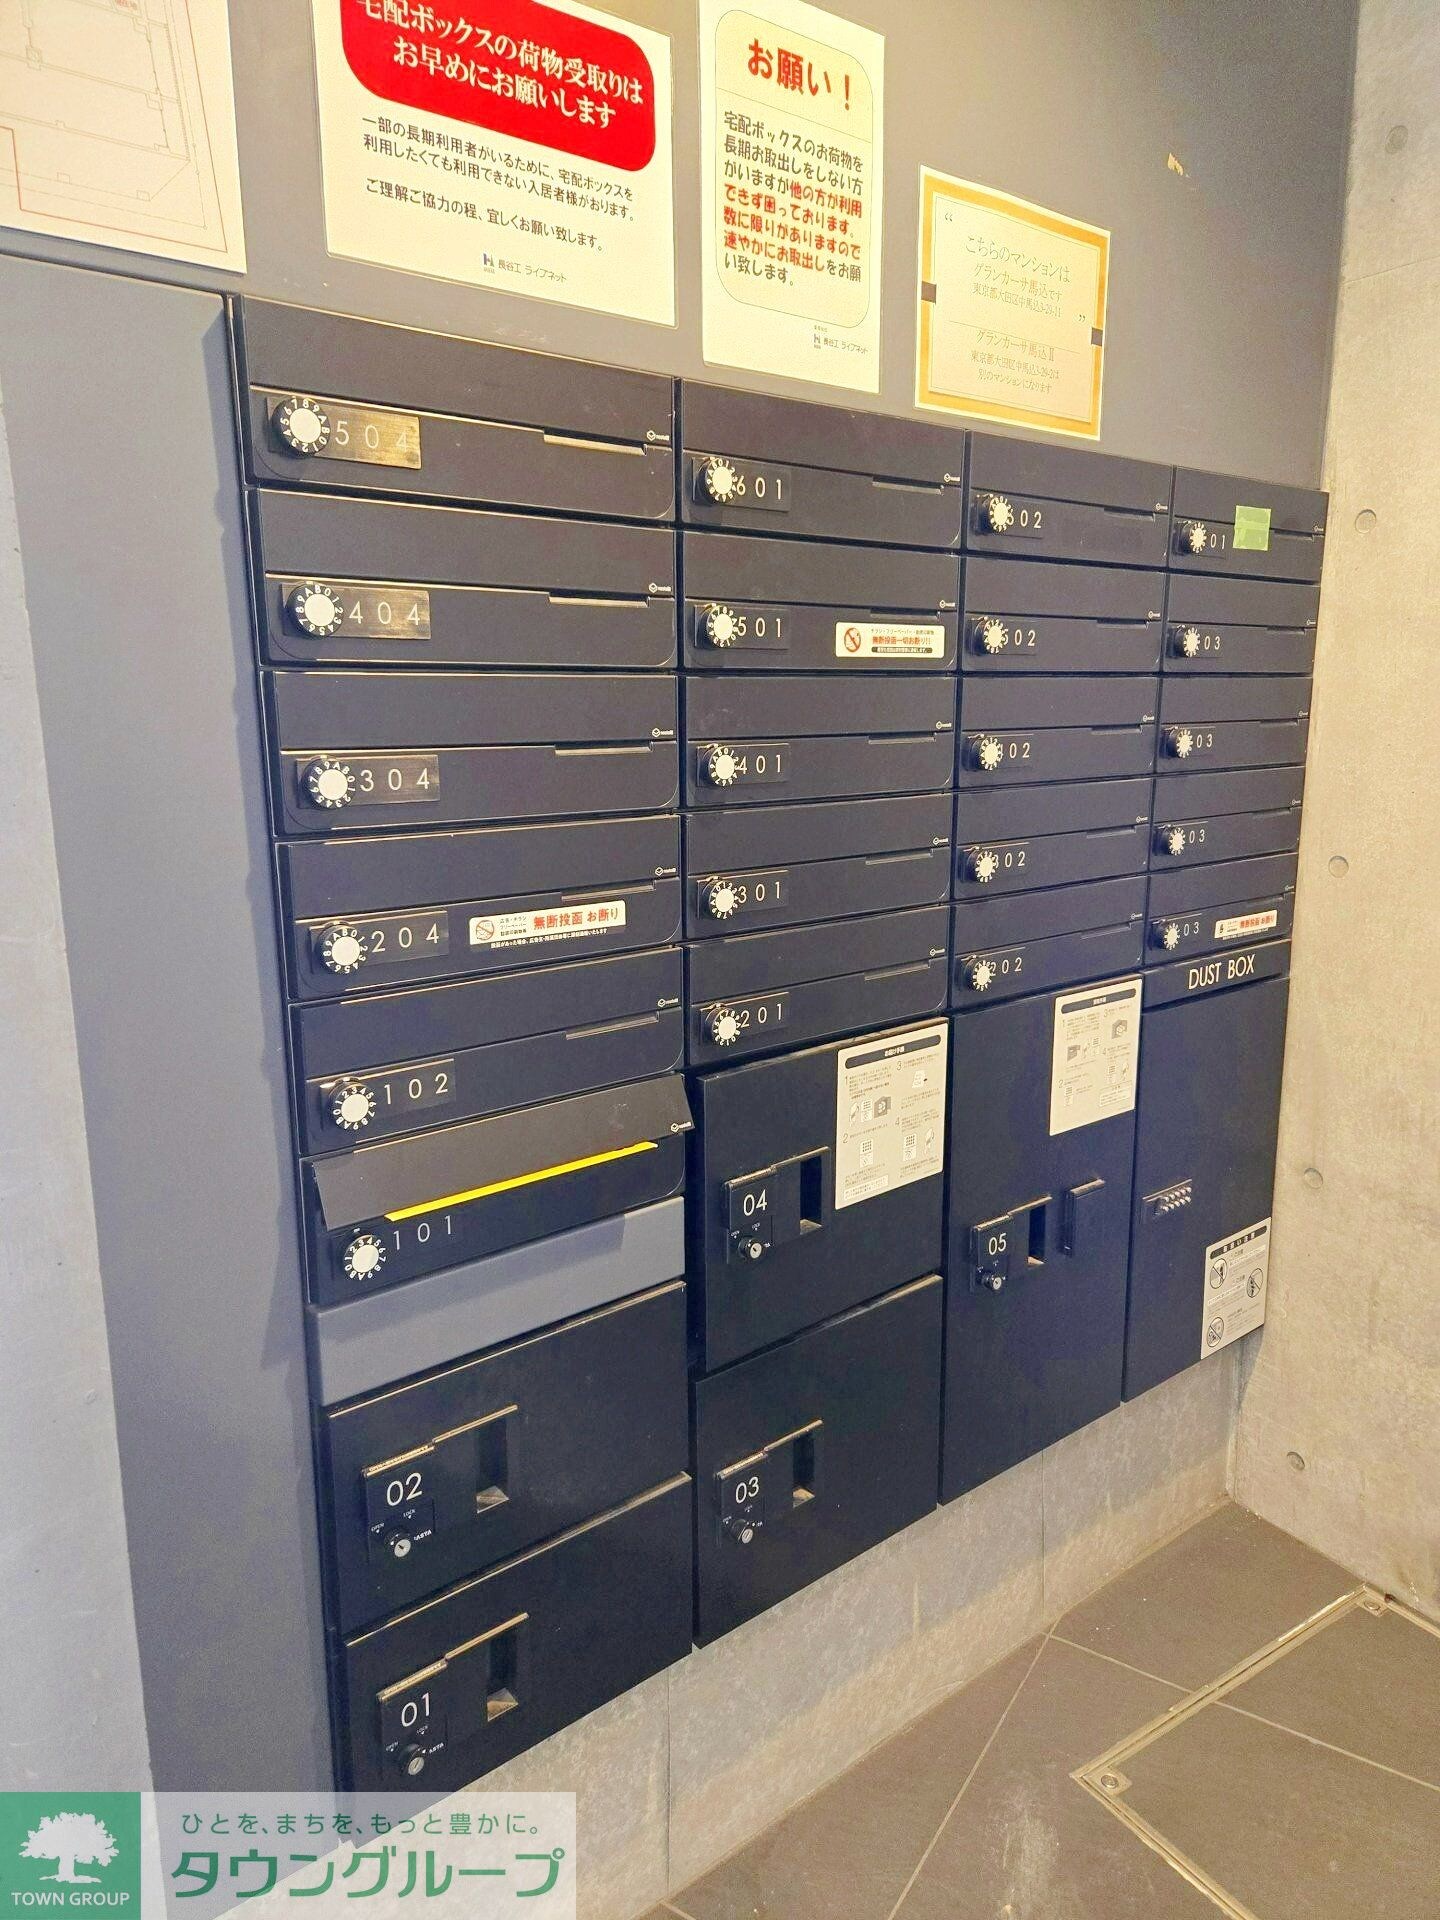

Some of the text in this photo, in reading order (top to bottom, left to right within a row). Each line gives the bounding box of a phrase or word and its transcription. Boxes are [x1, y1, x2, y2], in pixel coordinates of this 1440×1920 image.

[394, 35, 616, 129] お早めにお願いします
[362, 116, 634, 202] 一部の長期利用者がいるために、宅配ボックスを
[724, 111, 863, 173] 宅配ボックスのお荷物を
[363, 133, 634, 221] 利用したくても利用できない入居者様がおります。
[724, 134, 863, 195] 長期お取出しをしない方
[724, 161, 862, 218] がいますが他の方が利用
[366, 177, 603, 251] ご理解ご協力の程、宜しくお願い致します。
[724, 184, 853, 238] できず困っております。
[724, 206, 861, 260] 数に限りがありますので
[724, 230, 861, 282] 速やかにお取出しをお願
[725, 253, 793, 286] い致します。
[966, 236, 1070, 283] こちらのマンションは
[335, 421, 409, 452] 504
[736, 475, 782, 500] 601
[349, 601, 420, 626] 404
[737, 616, 782, 638] 501
[360, 767, 430, 792] 304
[738, 754, 782, 775] 401
[737, 881, 780, 903] 301
[587, 907, 619, 922] お断り
[371, 923, 439, 953] 204
[1188, 953, 1255, 990] DUST BOX
[740, 1003, 782, 1028] 201
[384, 1073, 448, 1105] 102
[743, 1189, 768, 1216] 04
[394, 1216, 451, 1251] 101
[988, 1232, 1007, 1256] 05
[386, 1472, 423, 1507] 02
[735, 1476, 760, 1503] 03
[401, 1692, 430, 1727] 01
